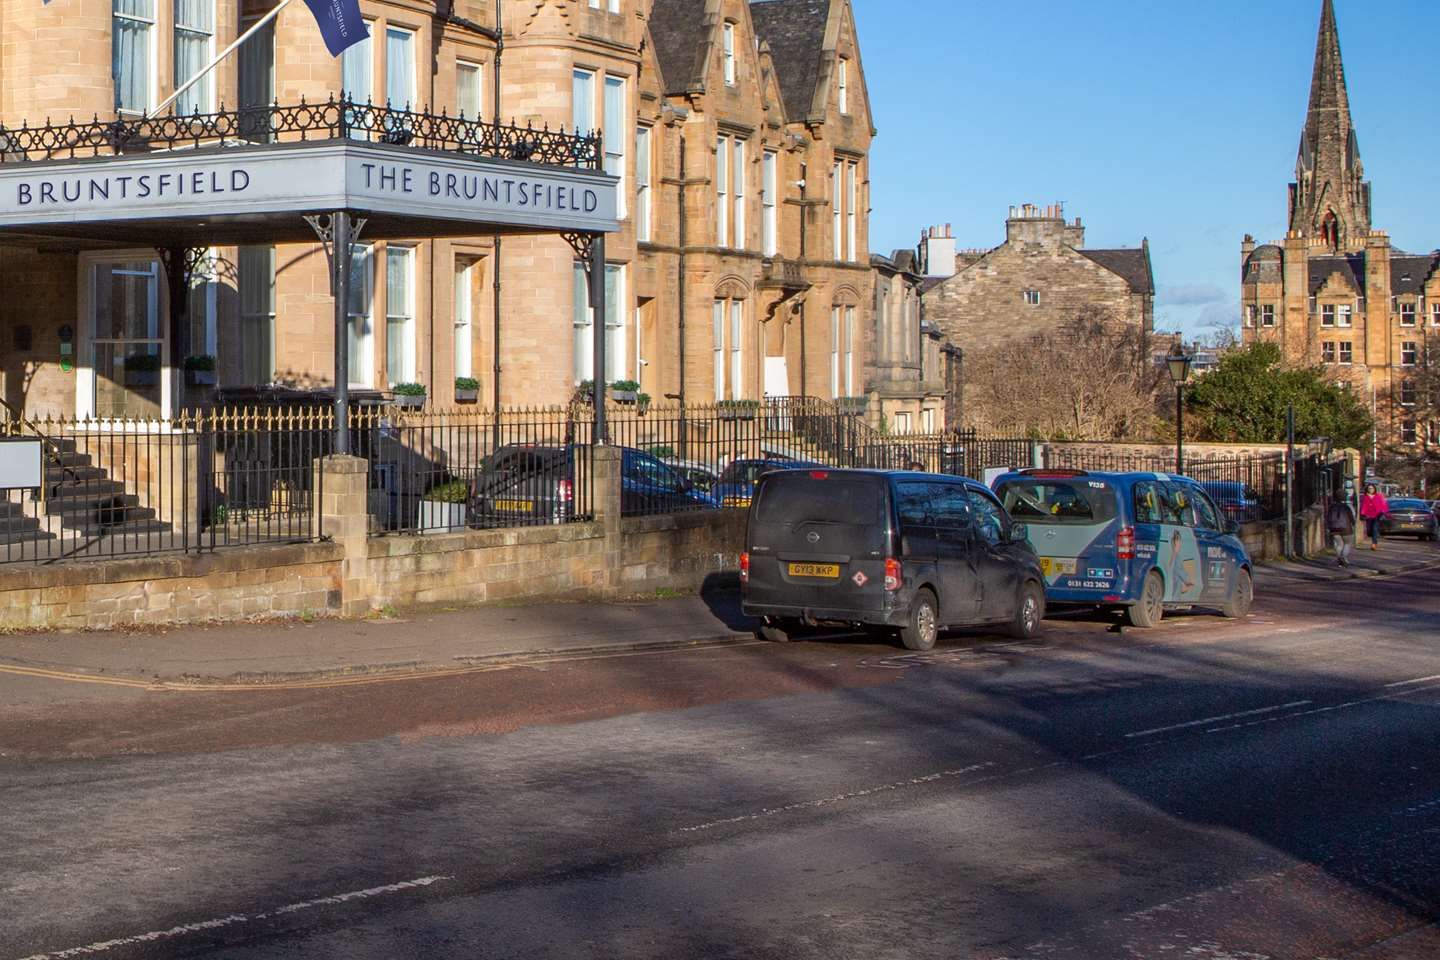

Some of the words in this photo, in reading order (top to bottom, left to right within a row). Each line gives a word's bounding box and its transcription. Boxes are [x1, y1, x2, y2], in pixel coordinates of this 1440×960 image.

[18, 169, 250, 205] BRUNTSFIELD
[362, 163, 412, 192] THE
[429, 171, 598, 212] BRUNTSFIELD
